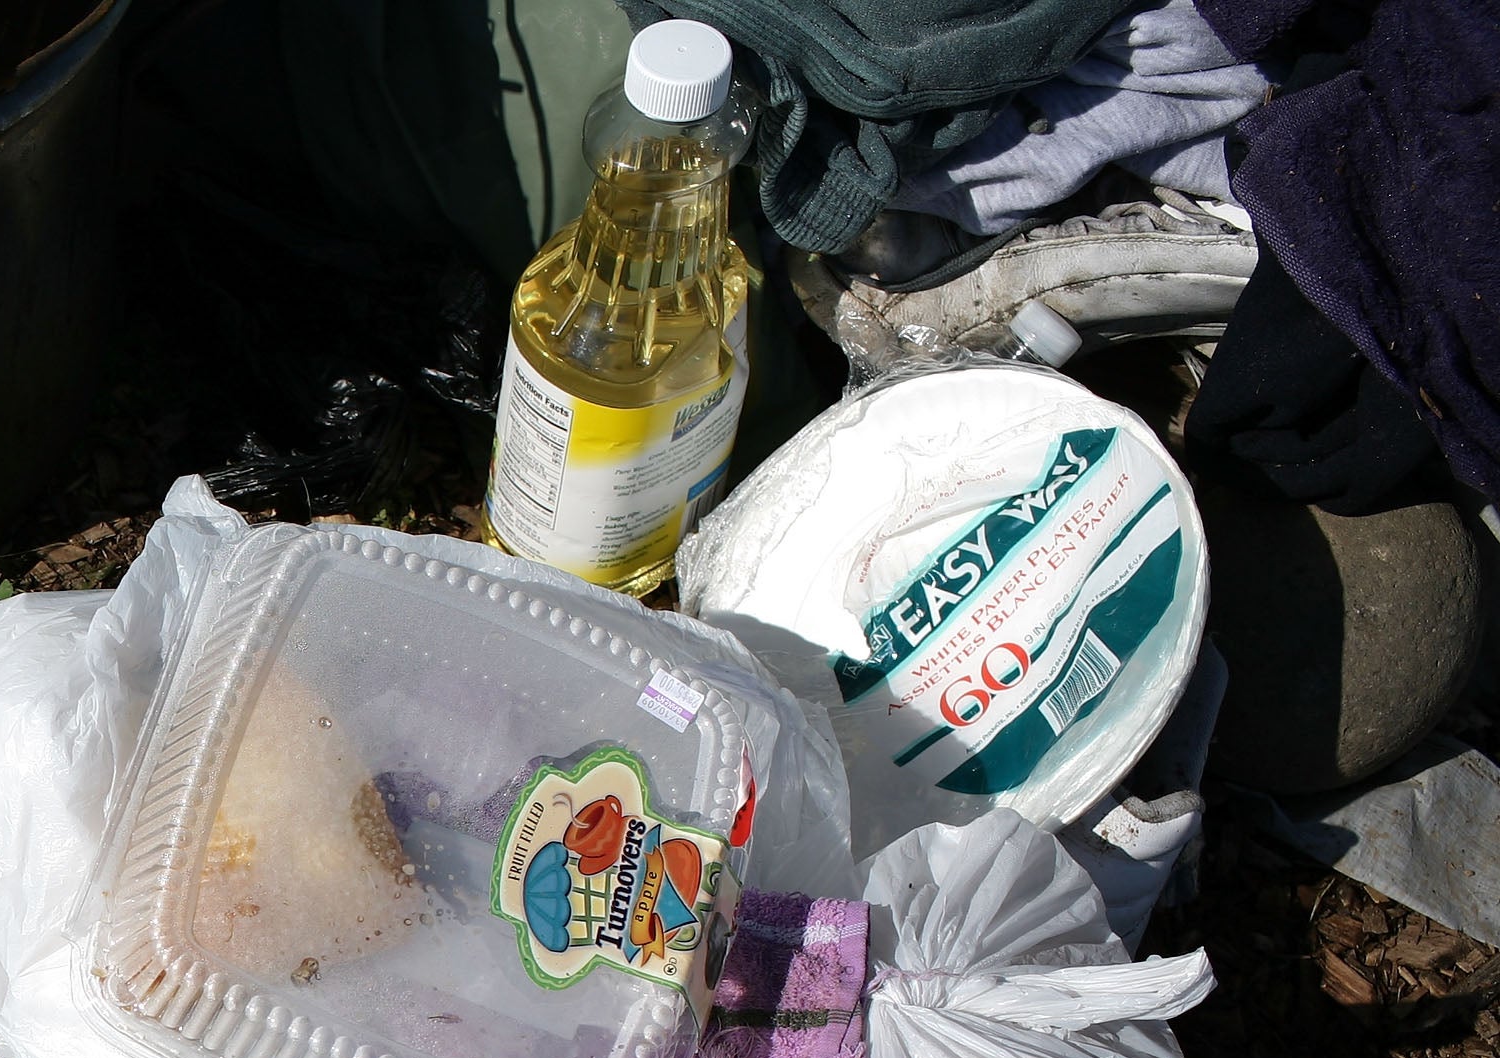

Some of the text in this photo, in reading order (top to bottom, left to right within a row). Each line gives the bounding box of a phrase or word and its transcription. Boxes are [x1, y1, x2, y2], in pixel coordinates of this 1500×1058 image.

[545, 396, 569, 418] Facts
[889, 442, 1088, 648] EASY WAY
[888, 634, 986, 715] ASSIETTES
[986, 572, 1047, 632] BLANC
[1047, 541, 1077, 570] EN
[1077, 473, 1129, 540] PAPIER
[911, 627, 971, 678] WHITE
[971, 570, 1027, 625] PAPER
[1026, 499, 1095, 567] PLATES
[1024, 634, 1034, 644] 9
[940, 643, 1029, 727] 60
[508, 801, 545, 881] FRUIT FILLED
[595, 818, 647, 950] Turnovers
[635, 871, 657, 922] apple
